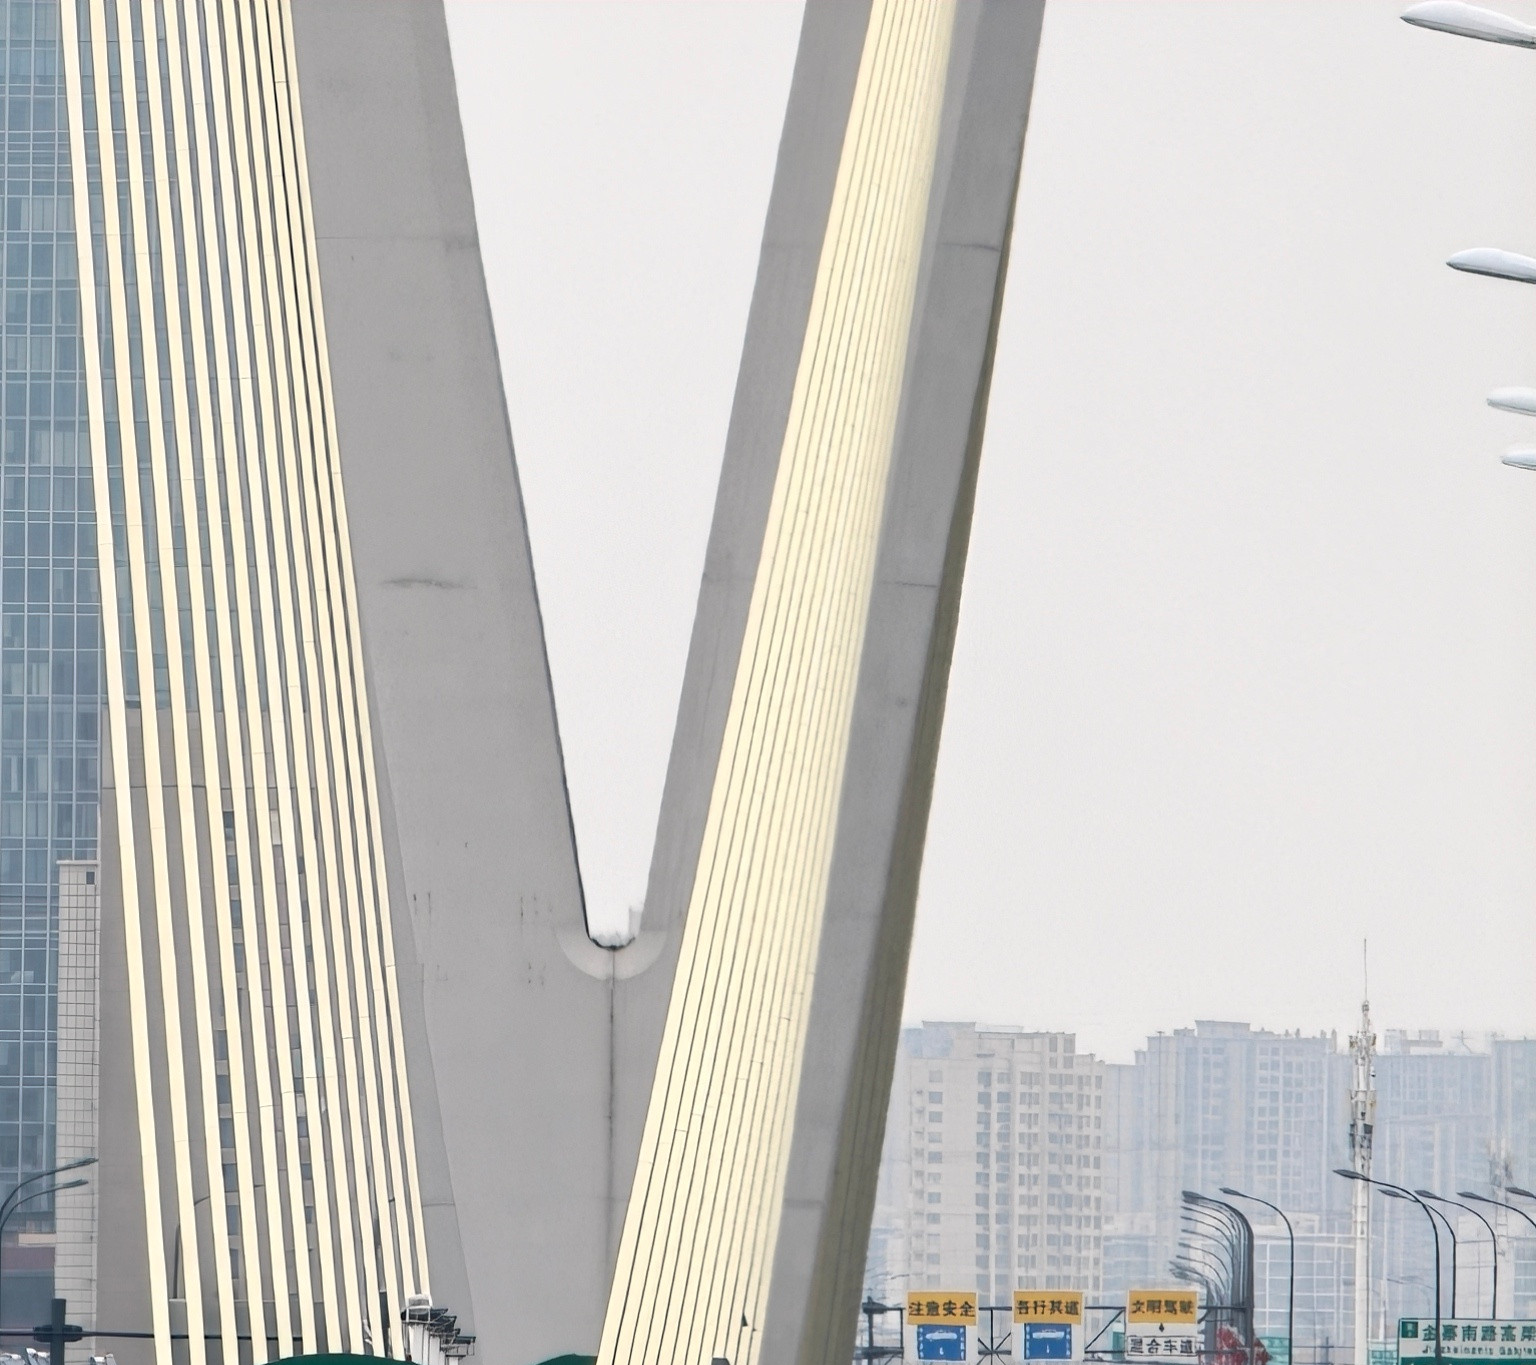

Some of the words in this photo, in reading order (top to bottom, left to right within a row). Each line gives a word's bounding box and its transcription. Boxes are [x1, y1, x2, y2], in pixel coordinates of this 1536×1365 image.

[908, 1299, 976, 1318] 注意安全
[1016, 1299, 1080, 1316] 各行其道
